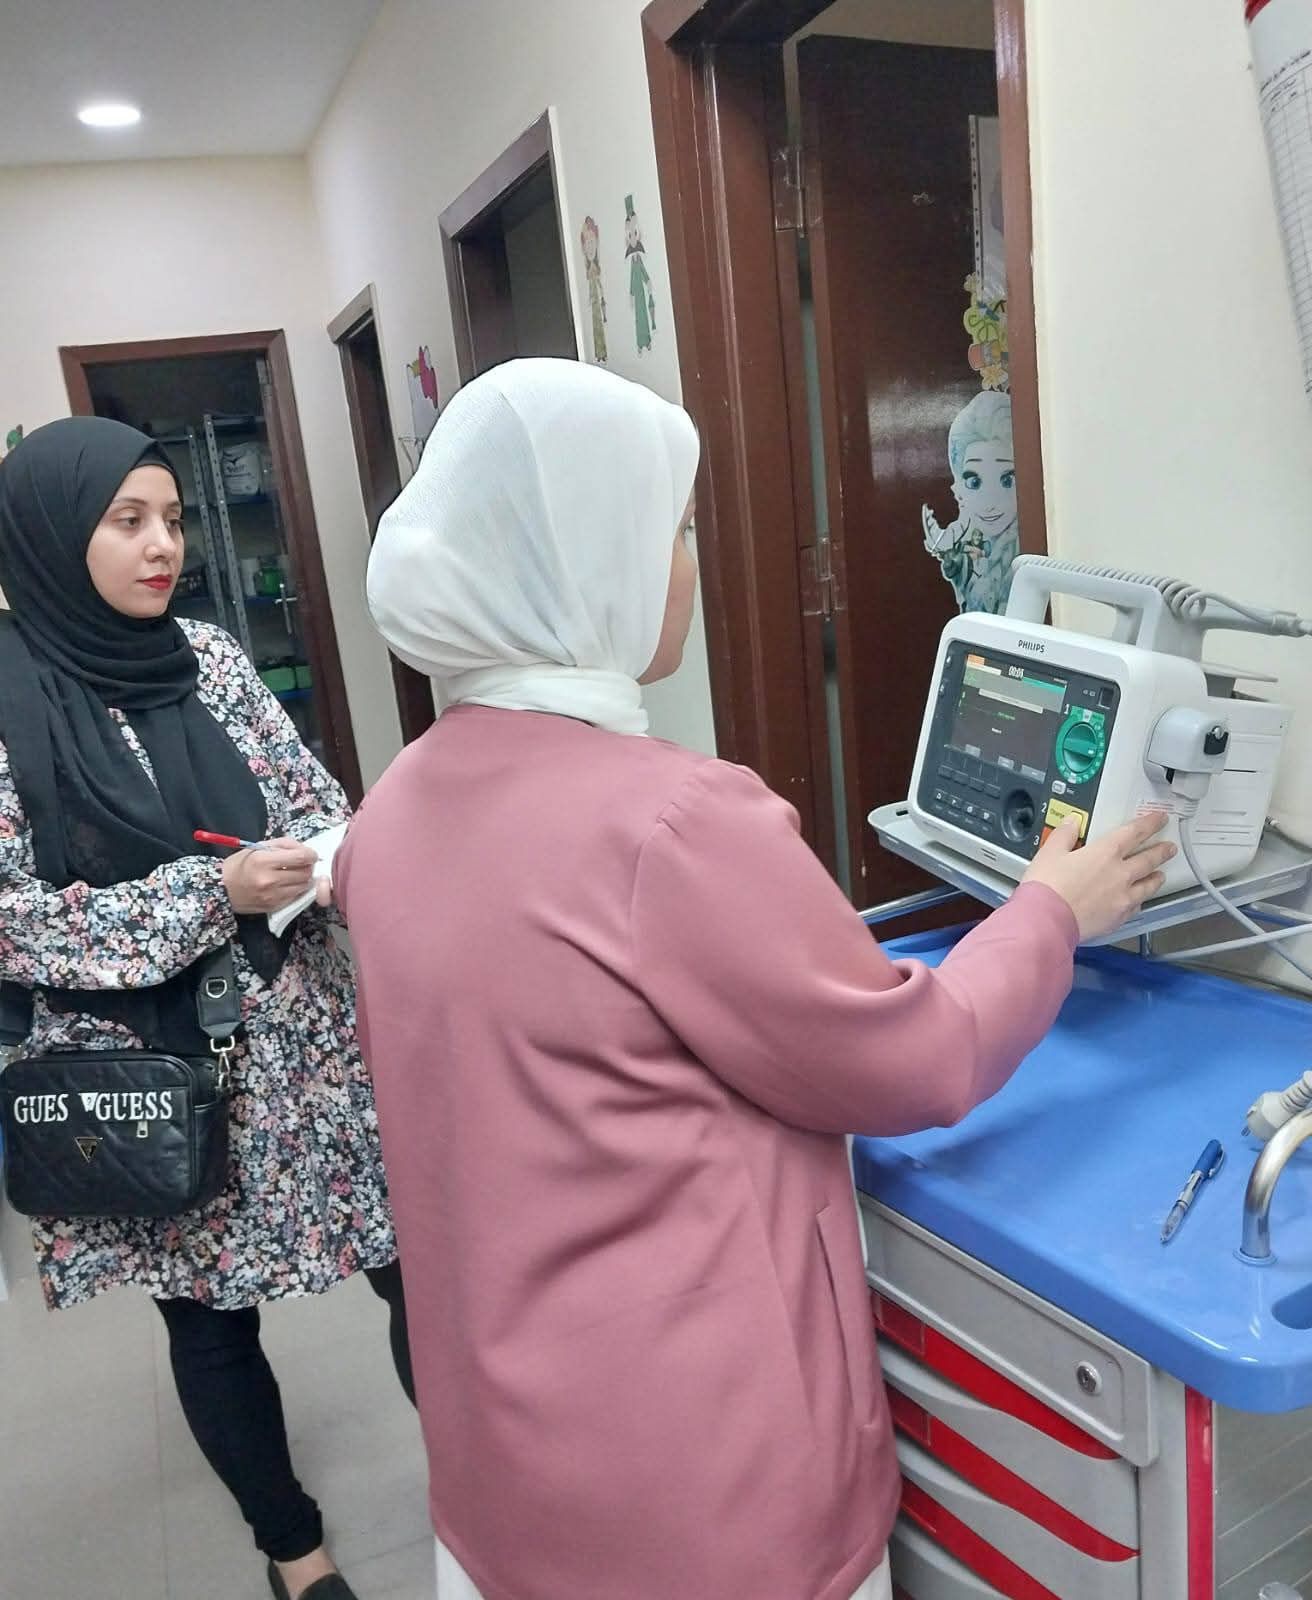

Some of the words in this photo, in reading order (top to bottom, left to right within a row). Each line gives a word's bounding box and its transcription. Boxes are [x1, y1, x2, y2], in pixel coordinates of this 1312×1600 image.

[1018, 639, 1045, 653] PHILIPS
[1063, 703, 1070, 715] 1
[1041, 802, 1047, 813] 2
[1033, 835, 1040, 846] 3
[14, 1093, 69, 1124] GUES
[95, 1091, 173, 1121] GUESS
